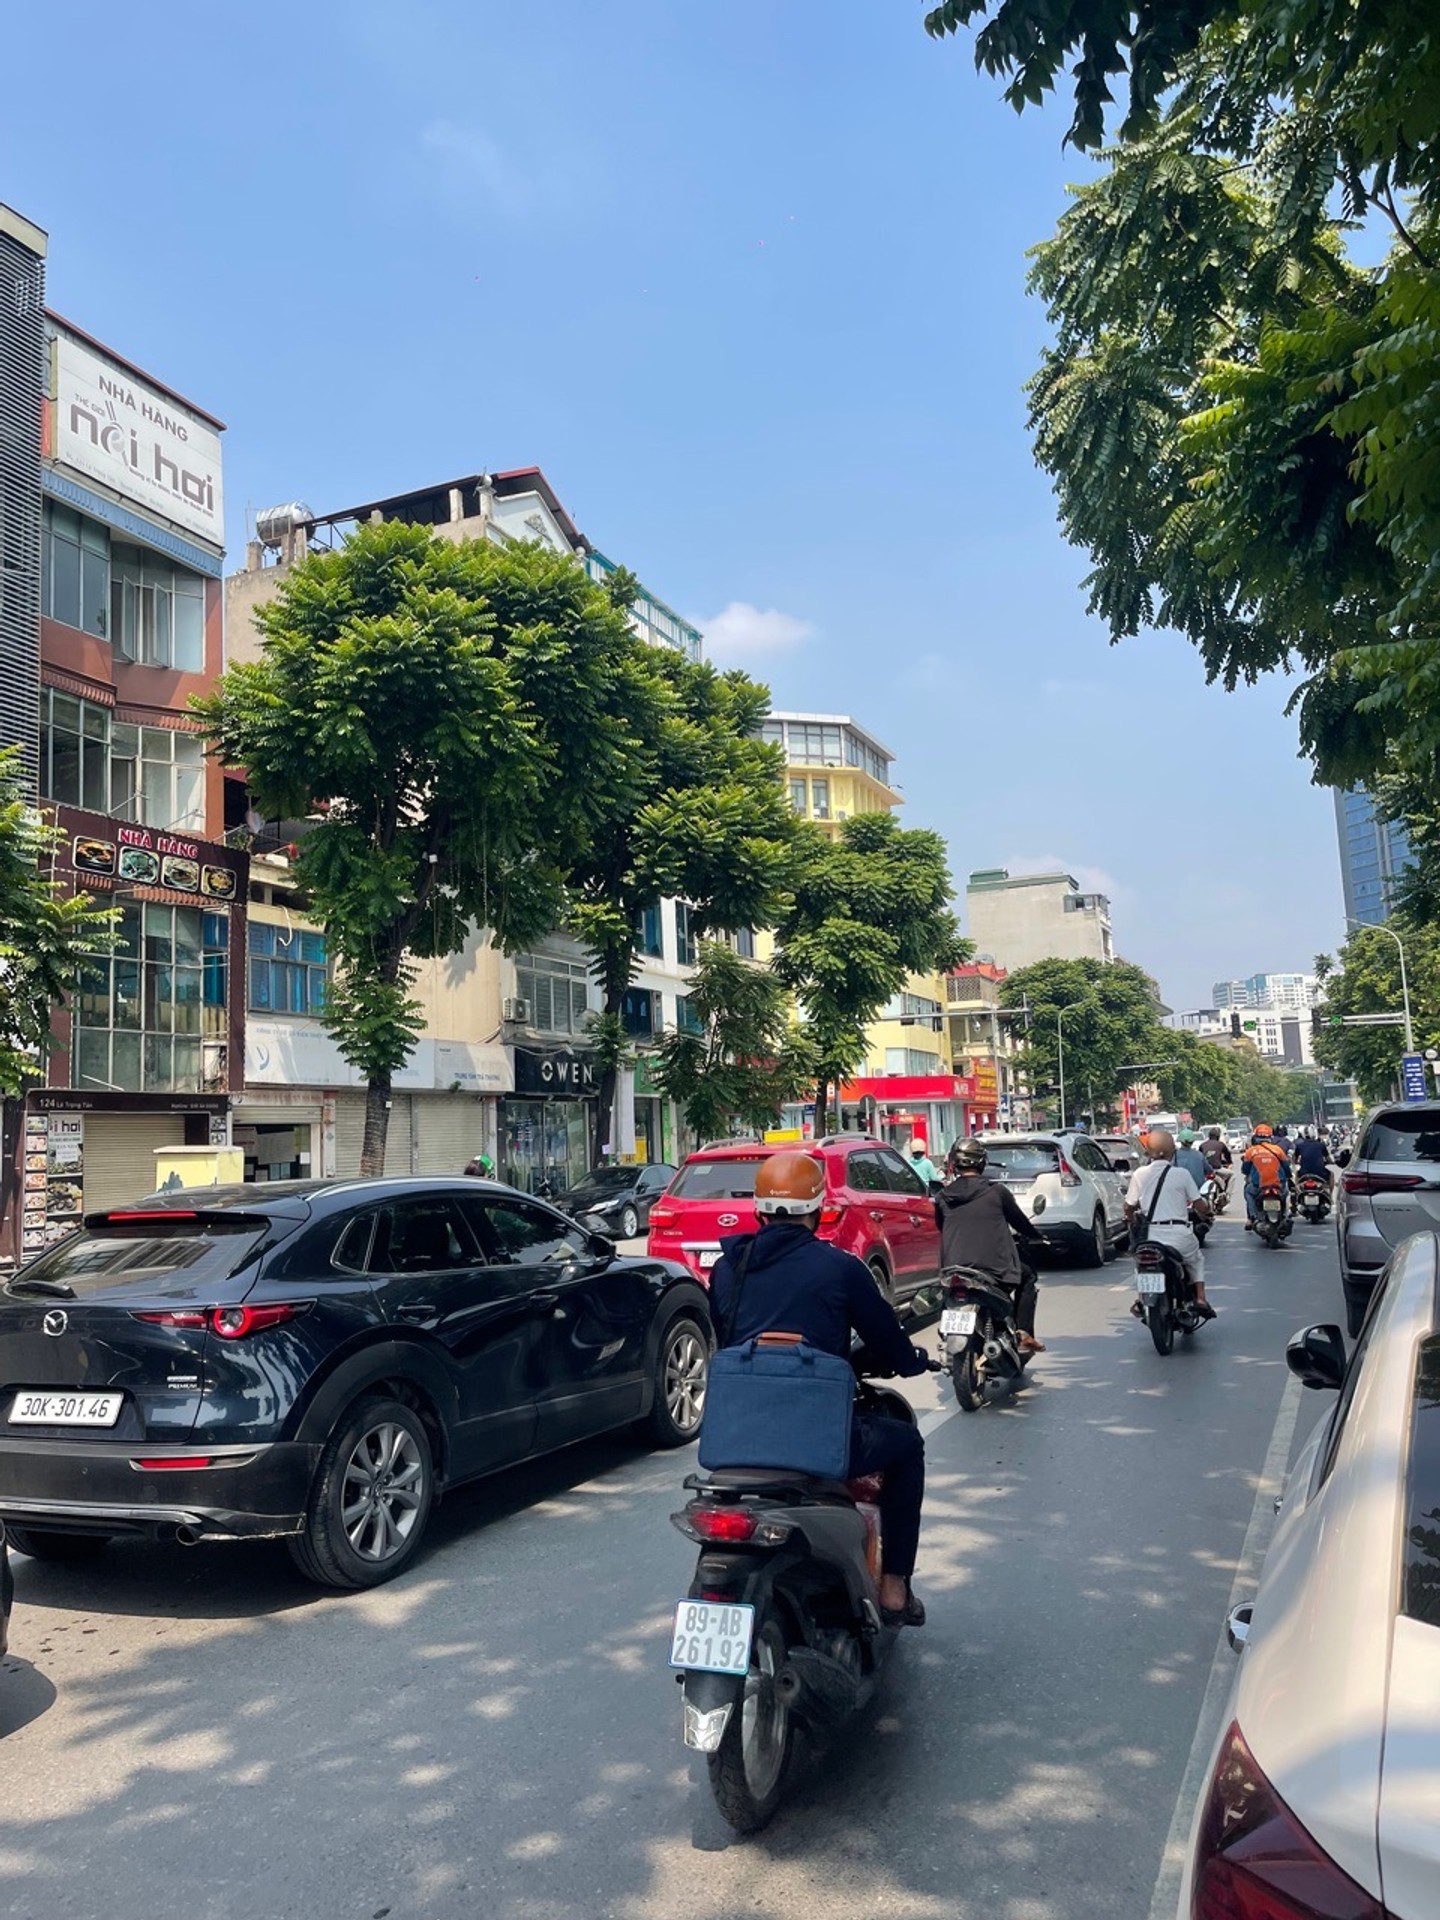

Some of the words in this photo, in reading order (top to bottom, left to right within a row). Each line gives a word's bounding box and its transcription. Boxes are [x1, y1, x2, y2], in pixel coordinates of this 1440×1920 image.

[99, 375, 137, 411] NHÀ
[142, 403, 188, 442] HÀNG
[154, 443, 215, 511] hơi
[117, 828, 152, 849] NHÀ
[157, 837, 198, 858] HÀNG
[541, 1060, 594, 1084] OWEN
[40, 1098, 55, 1108] 124
[685, 1605, 742, 1636] 89-AB
[674, 1635, 746, 1669] 261.92
